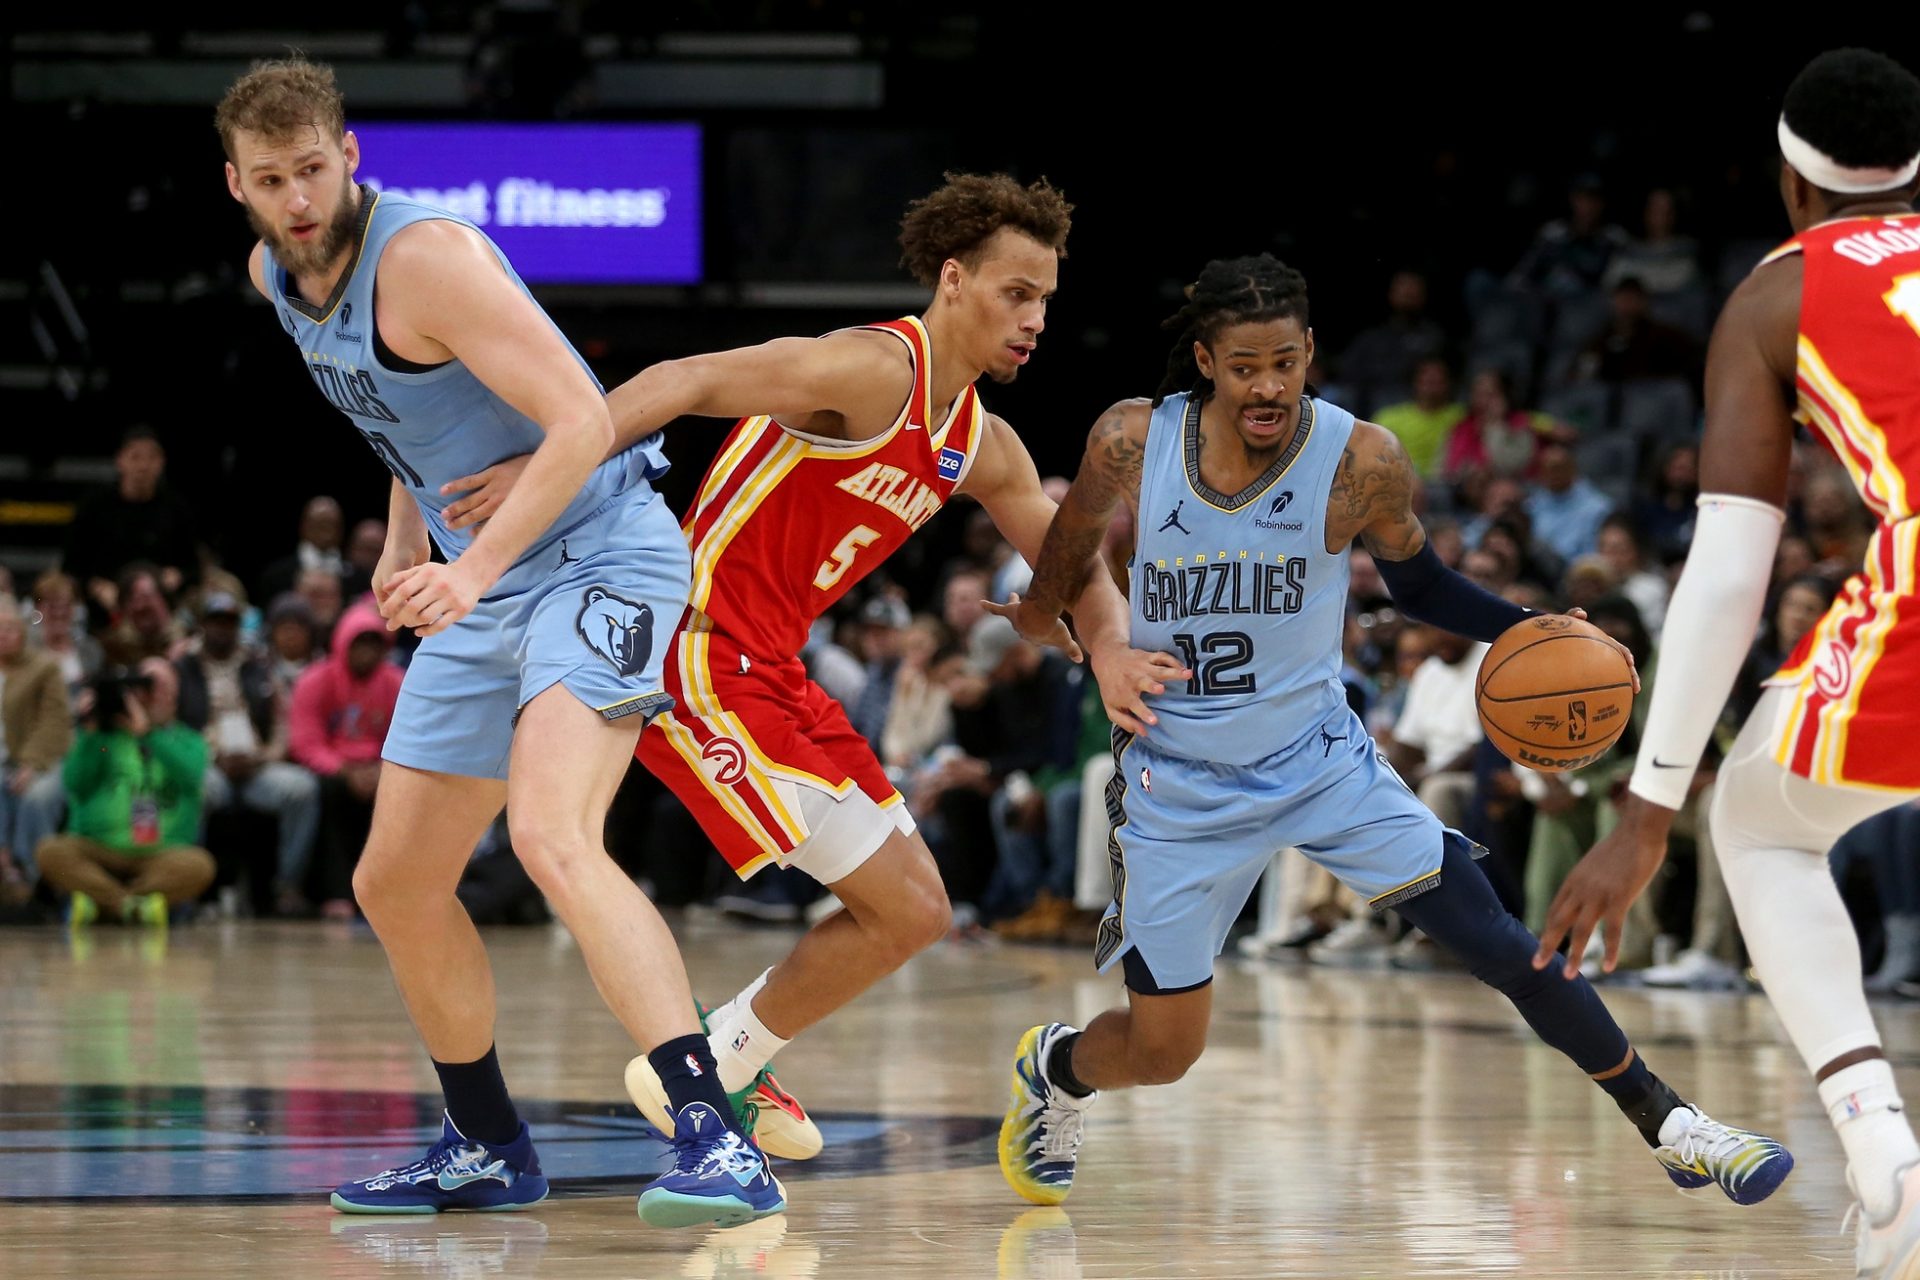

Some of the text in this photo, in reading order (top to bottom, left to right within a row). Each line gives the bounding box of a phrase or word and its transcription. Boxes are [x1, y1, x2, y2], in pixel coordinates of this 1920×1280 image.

[495, 177, 667, 227] fitness
[303, 352, 355, 373] EMPHIS
[938, 455, 960, 471] aze
[834, 461, 943, 533] ATLANT
[1255, 519, 1303, 531] Robinhood
[813, 524, 882, 591] 5
[1157, 550, 1286, 569] MEMPHIS
[1143, 557, 1306, 623] GRIZZLIES
[1172, 631, 1257, 696] 12
